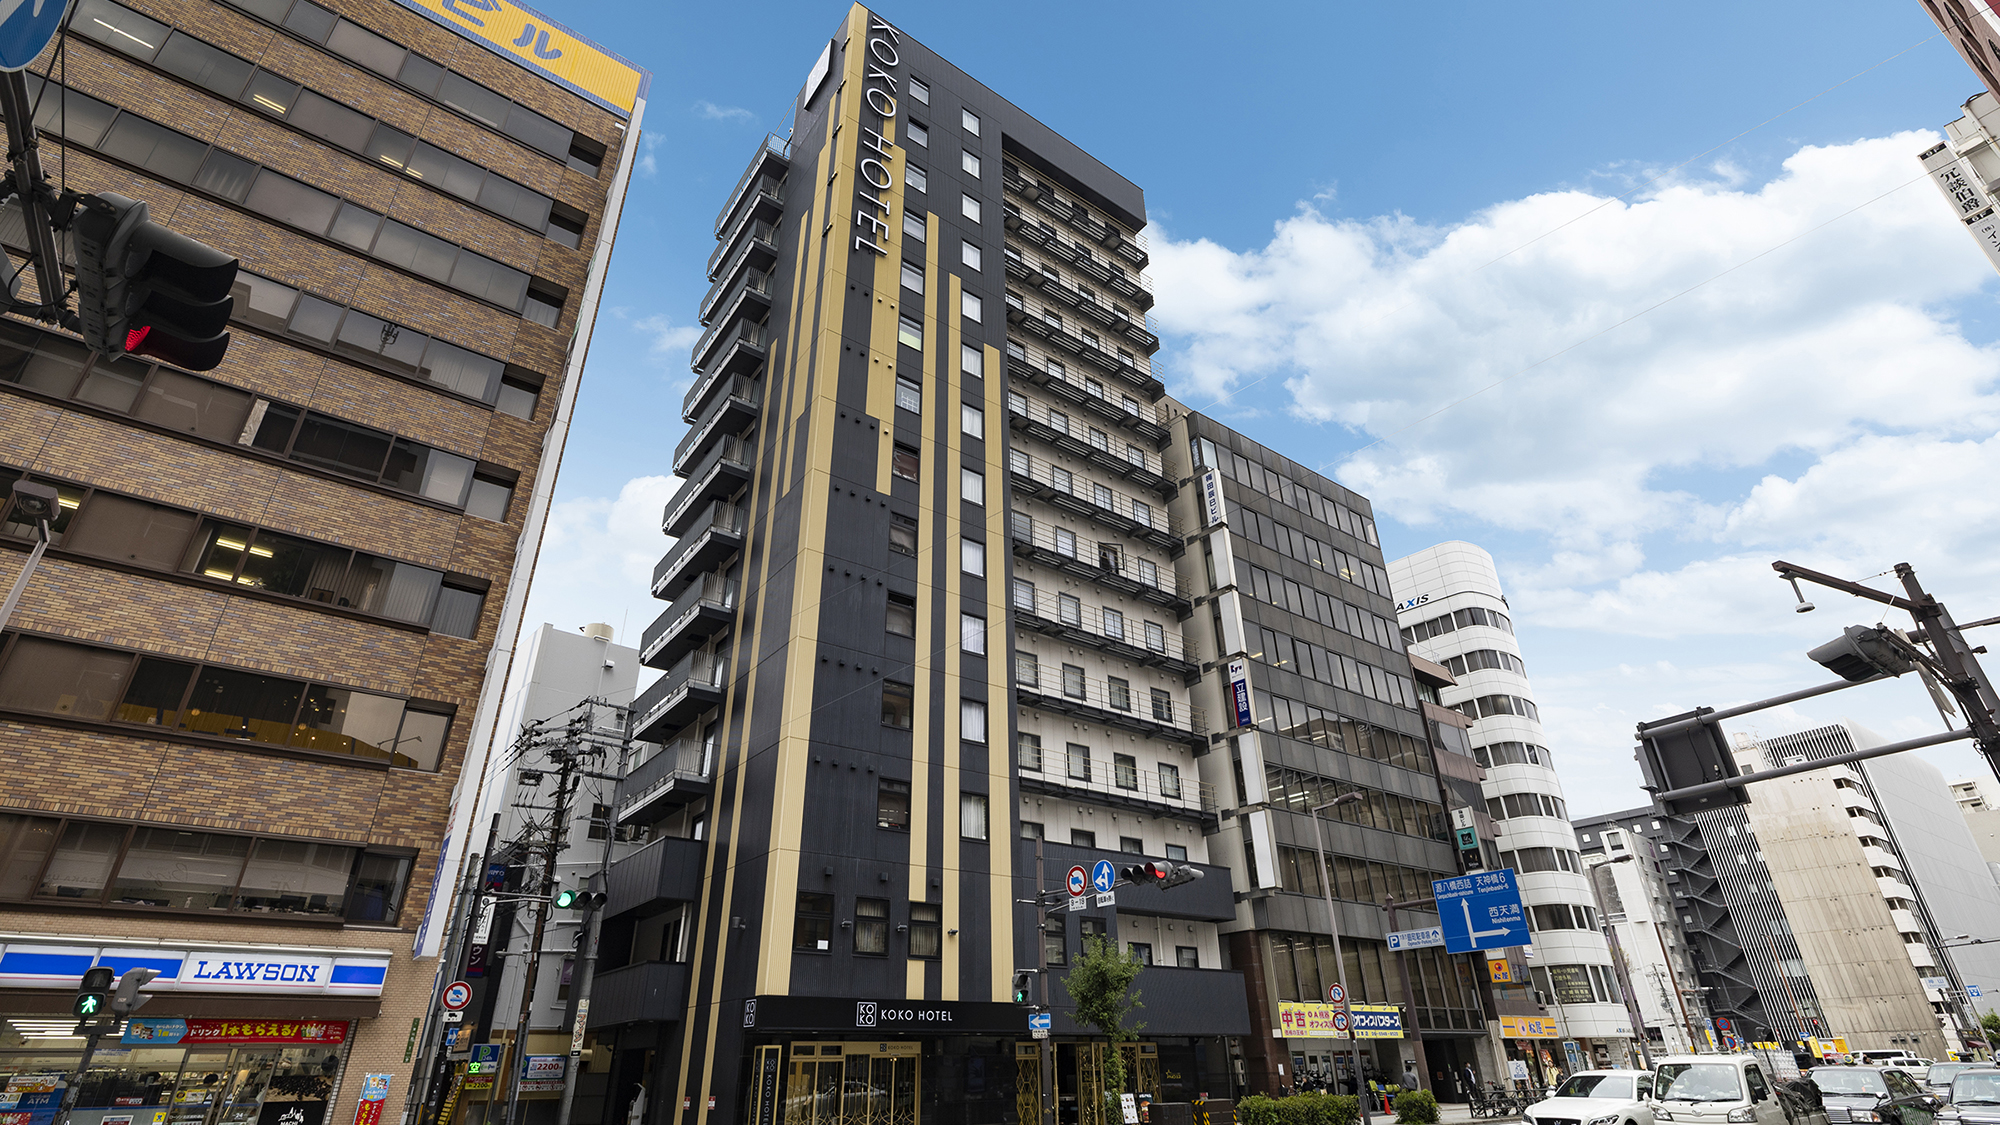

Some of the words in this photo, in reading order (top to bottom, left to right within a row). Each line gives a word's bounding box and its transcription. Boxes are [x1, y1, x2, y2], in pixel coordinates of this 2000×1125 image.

[866, 15, 900, 119] KOKO
[855, 126, 894, 256] HOTEL
[1395, 594, 1429, 612] AXIS
[1488, 903, 1520, 918] 西天満
[1491, 915, 1521, 925] Nishitenma
[193, 960, 320, 983] LAWSON
[1494, 972, 1509, 980] 松屋
[859, 1004, 874, 1014] KO
[881, 1009, 914, 1021] KOKO
[918, 1010, 953, 1022] HOTEL
[859, 1014, 874, 1024] KO
[1281, 1009, 1306, 1029] 中古
[1528, 1021, 1543, 1034] 松屋
[478, 1045, 491, 1061] P
